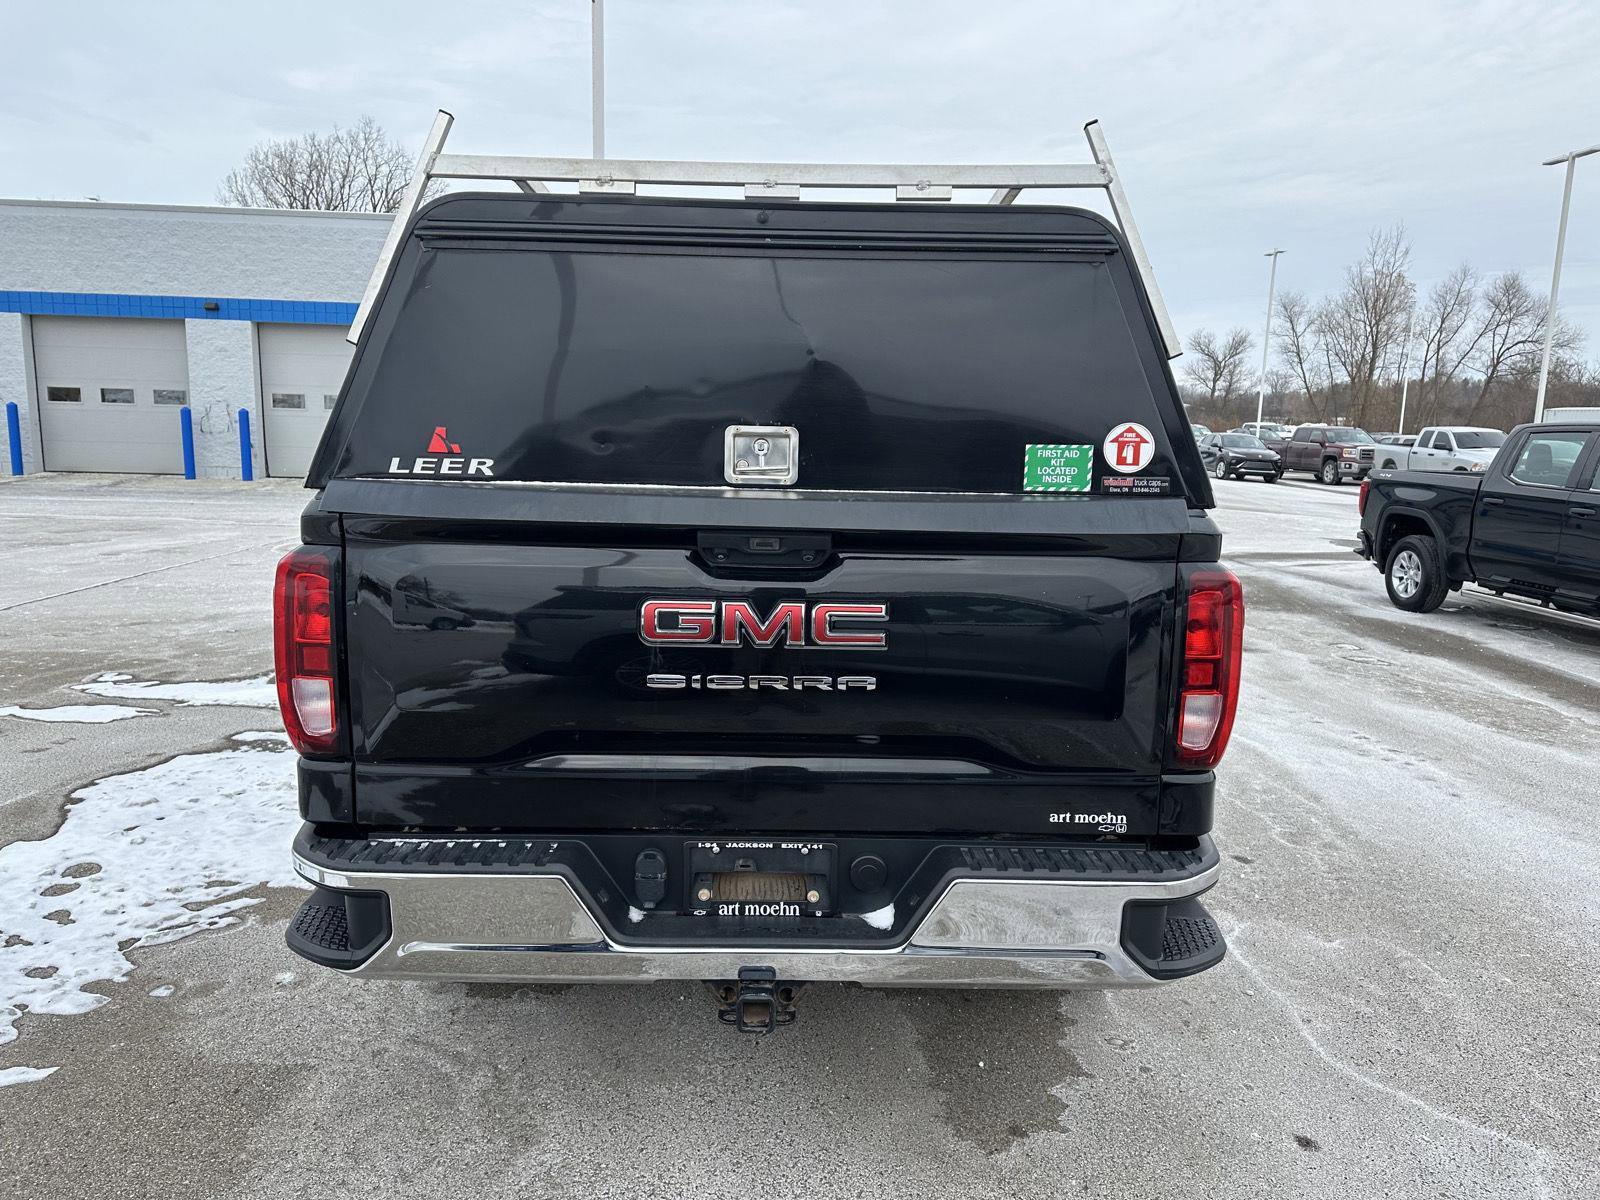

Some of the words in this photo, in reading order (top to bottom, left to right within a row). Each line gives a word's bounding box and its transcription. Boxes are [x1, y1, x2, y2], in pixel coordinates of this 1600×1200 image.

[1037, 449, 1062, 458] FIRST
[1063, 450, 1080, 458] AID
[388, 457, 495, 476] LEER
[1050, 458, 1066, 466] KIT
[1037, 466, 1079, 475] LOCATED
[1042, 475, 1072, 483] INSIDE
[638, 599, 890, 649] GMC
[646, 674, 877, 691] SIERRA
[1049, 812, 1072, 823] art
[1074, 812, 1127, 824] moehn
[718, 903, 740, 916] art
[744, 901, 800, 916] moehn
